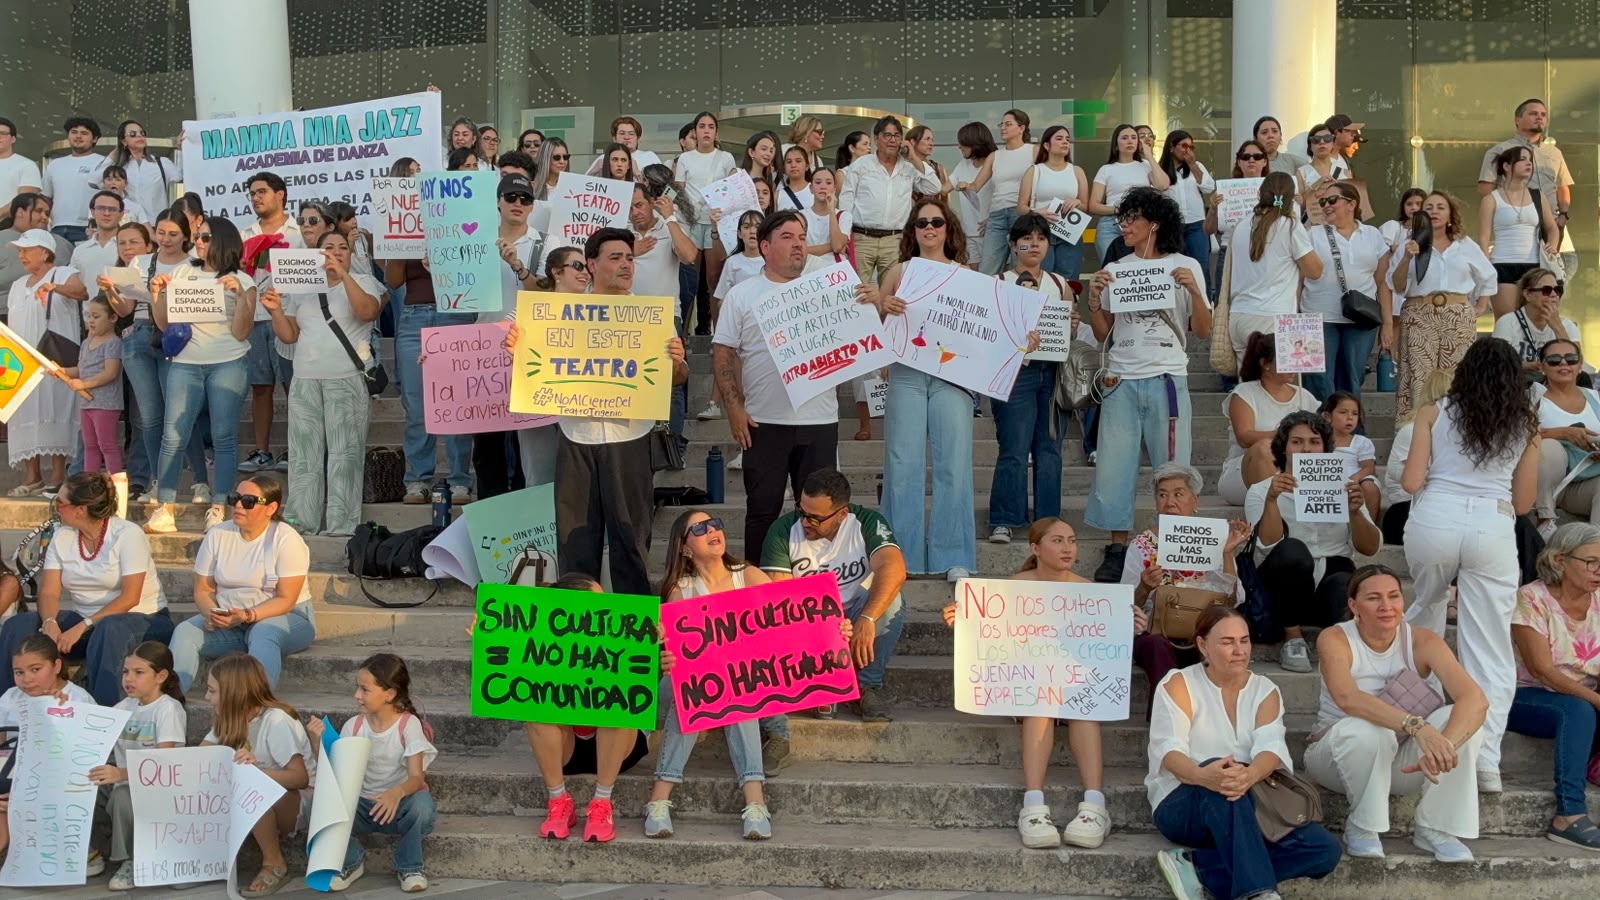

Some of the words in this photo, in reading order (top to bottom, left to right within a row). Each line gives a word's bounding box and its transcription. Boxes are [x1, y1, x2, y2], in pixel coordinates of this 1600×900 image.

[787, 108, 796, 120] 3
[200, 120, 297, 160] MAMMA
[302, 114, 353, 147] MIA
[358, 105, 422, 141] JAZZ
[235, 149, 311, 172] ACADEMIA
[313, 147, 335, 164] DE
[337, 142, 389, 161] DANZA
[205, 183, 227, 198] NO
[334, 168, 365, 183] LAS
[373, 179, 392, 190] POR
[439, 175, 473, 199] NOS
[585, 181, 608, 194] SIN
[362, 191, 373, 204] A
[573, 193, 621, 216] TEATRO
[571, 211, 589, 223] NO
[591, 213, 612, 228] HAY
[457, 271, 476, 287] DIO
[1116, 267, 1165, 279] ESCUCHEN
[1130, 278, 1137, 286] A
[1138, 277, 1151, 285] LA
[174, 288, 215, 296] EXIGIMOS
[780, 285, 810, 304] MAS
[808, 276, 826, 294] DE
[825, 270, 848, 288] 100
[1113, 283, 1171, 296] COMUNIDAD
[821, 293, 833, 310] AL
[532, 302, 557, 321] EL
[561, 303, 610, 322] ARTE
[614, 305, 664, 325] VIVE
[788, 324, 802, 341] DE
[804, 303, 861, 335] ARTISTAS
[926, 308, 959, 332] TEATRO
[951, 308, 967, 320] DEL
[1279, 318, 1293, 326] NO
[425, 330, 492, 354] Cuando
[546, 327, 575, 348] EN
[587, 328, 642, 349] ESTE
[779, 345, 797, 363] SIN
[799, 329, 843, 354] LUGAR
[809, 342, 859, 373] ABIERTO
[858, 333, 884, 354] YA
[452, 358, 471, 372] no
[549, 357, 638, 378] TEATRO
[432, 381, 455, 404] la
[434, 408, 452, 423] se
[1299, 458, 1314, 466] NO
[1316, 458, 1344, 466] ESTOY
[1324, 466, 1344, 474] POR
[1304, 502, 1342, 514] ARTE
[1165, 534, 1219, 546] RECORTES
[1174, 524, 1212, 536] MENOS
[1166, 554, 1212, 565] CULTURA
[1180, 545, 1203, 555] MAS
[739, 594, 843, 635] CULTURA
[1015, 595, 1046, 617] nos
[1051, 593, 1113, 621] quiten
[478, 597, 538, 633] SIN
[547, 607, 658, 645] CULTURA
[979, 620, 1002, 638] los
[1006, 620, 1059, 643] lugares
[1065, 620, 1108, 638] donde
[521, 636, 564, 667] NO
[568, 642, 626, 675] HAY
[976, 640, 1009, 662] Los
[1013, 639, 1070, 659] Mochis
[680, 672, 725, 711] NO
[726, 653, 781, 697] HAY
[968, 662, 1036, 684] SUEÑAN
[1046, 664, 1055, 684] Y
[1064, 664, 1086, 684] SE
[974, 685, 1064, 707] EXPRESAN
[138, 757, 184, 788] QUE
